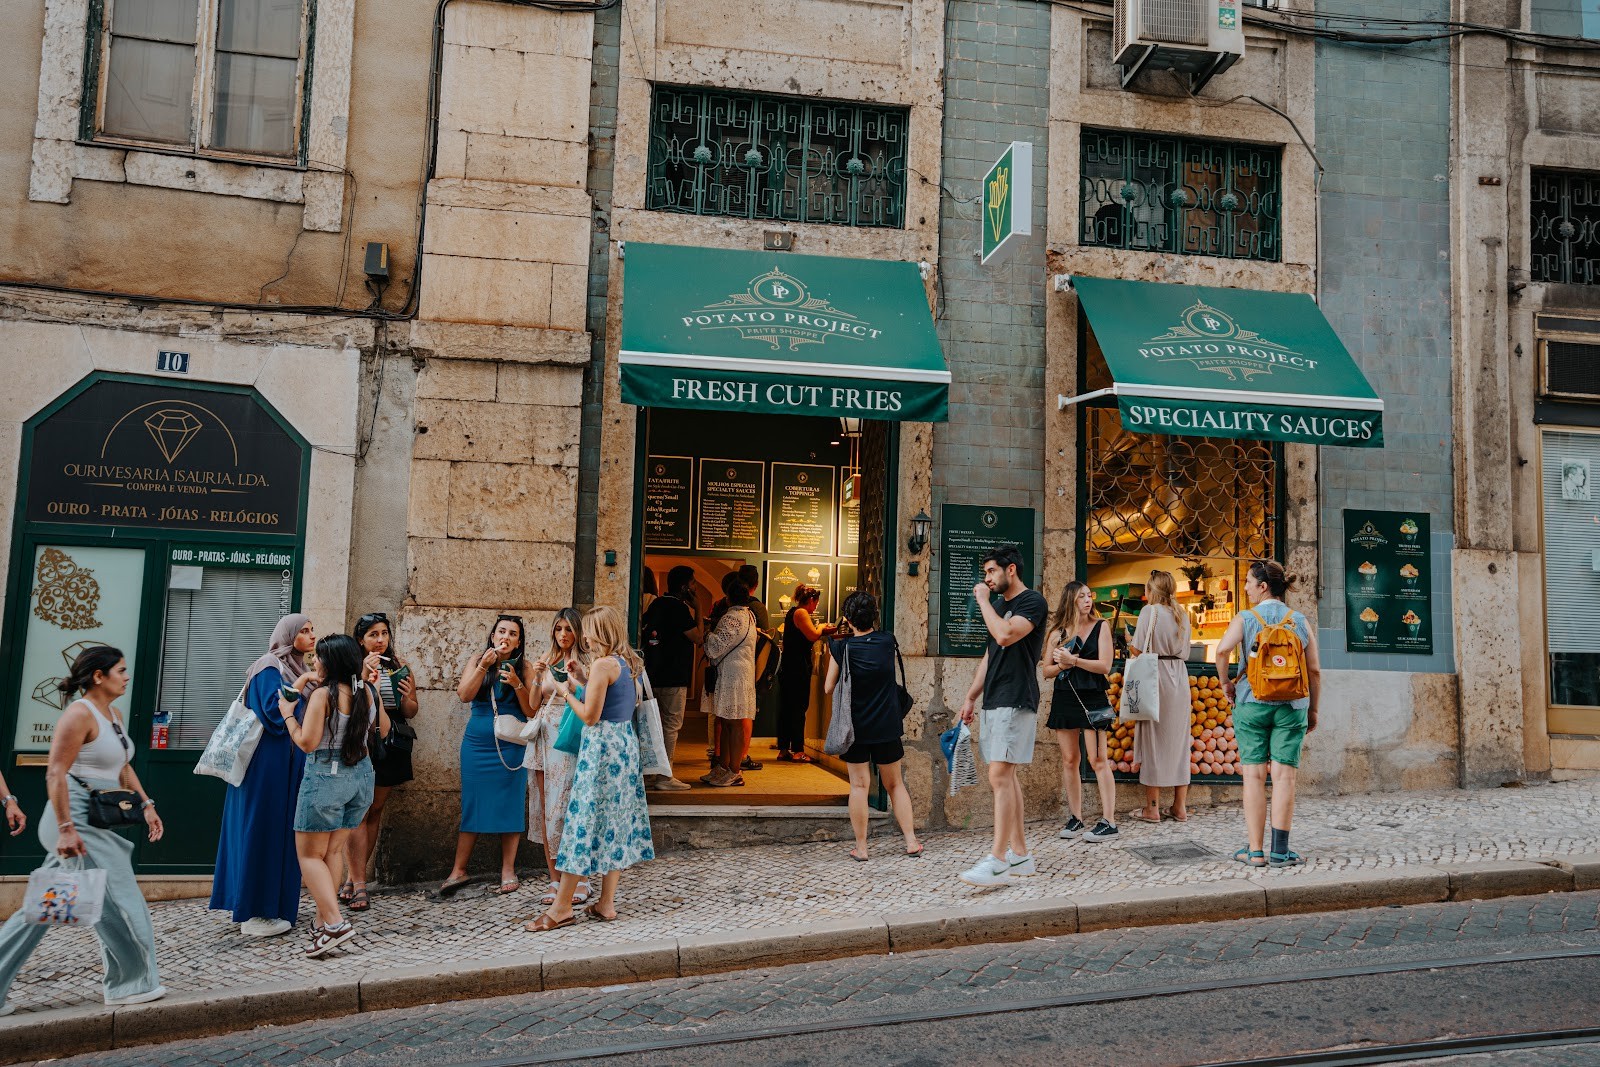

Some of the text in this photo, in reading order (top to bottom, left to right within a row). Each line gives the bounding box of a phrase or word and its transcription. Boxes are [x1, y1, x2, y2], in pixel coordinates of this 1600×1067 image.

[773, 233, 783, 247] 8
[682, 312, 882, 339] POTATO PROJECT
[747, 327, 818, 338] FRITE SHOPPE
[163, 352, 183, 371] 10
[1138, 344, 1318, 369] POTATO PROJECT
[672, 378, 902, 411] FRESH CUT FRIES
[1129, 405, 1373, 440] SPECIALITY SAUCES
[64, 463, 170, 481] OURIVESARIA
[237, 473, 270, 488] LDA.
[126, 482, 208, 495] COMPRA E VENDA
[47, 501, 279, 525] OURO PRATA JÓIAS RELÓGIOS
[646, 504, 678, 513] édio/Regular
[172, 549, 291, 566] OURO PRATAS JÓIAS RELÓGIOS
[279, 569, 290, 620] OURIVE
